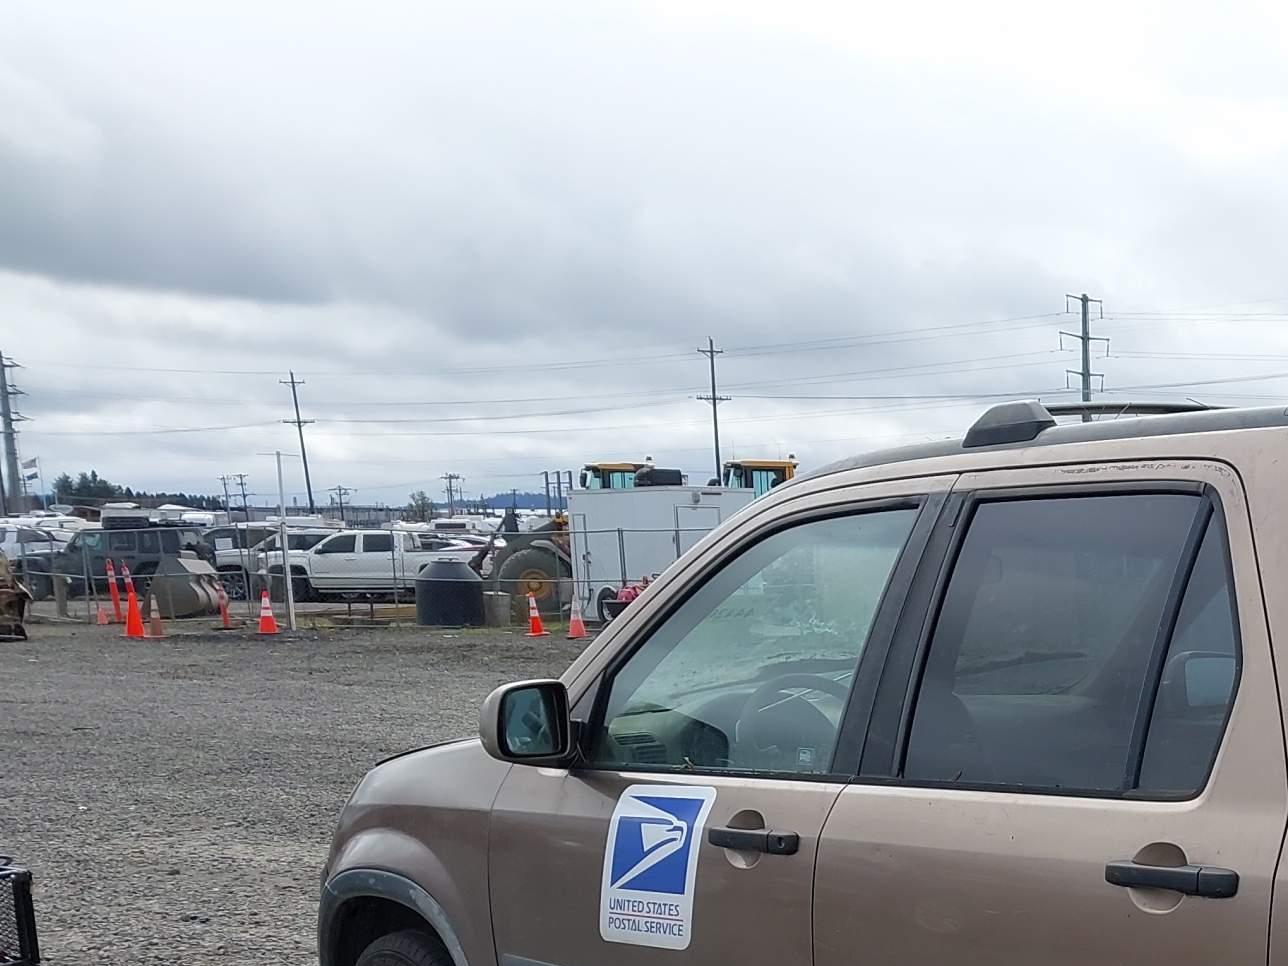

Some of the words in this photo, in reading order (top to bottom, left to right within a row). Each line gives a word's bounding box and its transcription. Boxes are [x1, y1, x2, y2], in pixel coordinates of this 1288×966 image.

[609, 898, 644, 914] UNITED
[646, 901, 680, 917] STATES
[608, 916, 643, 932] POSTAL
[643, 919, 684, 937] SERVICE
